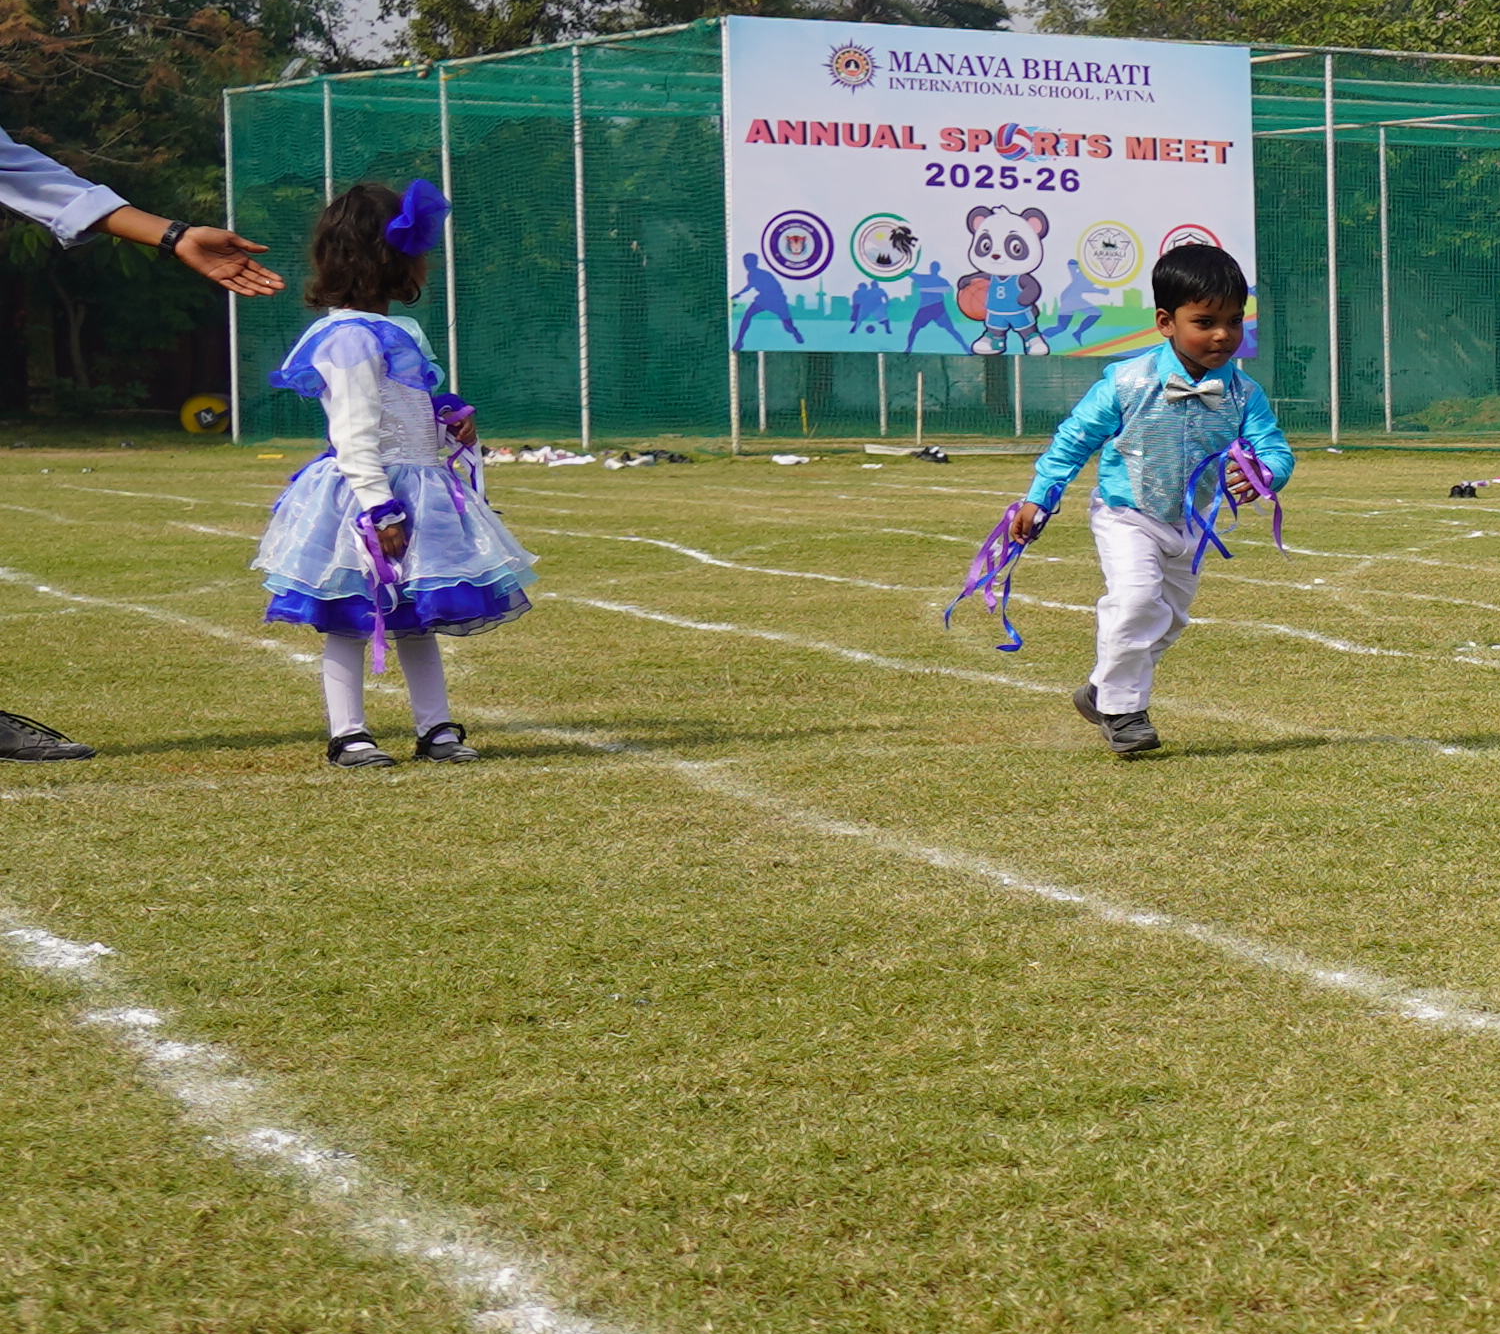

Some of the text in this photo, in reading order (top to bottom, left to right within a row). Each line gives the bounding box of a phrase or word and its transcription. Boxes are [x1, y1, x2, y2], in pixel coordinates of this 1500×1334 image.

[888, 50, 1152, 87] MANAVA BHARATI
[888, 76, 1155, 103] INTERNATIONAL SCHOOL, PATNA
[745, 118, 927, 150] ANNUAL
[1125, 135, 1234, 165] MEET
[924, 162, 1080, 193] 2025-26
[996, 285, 1006, 299] 8
